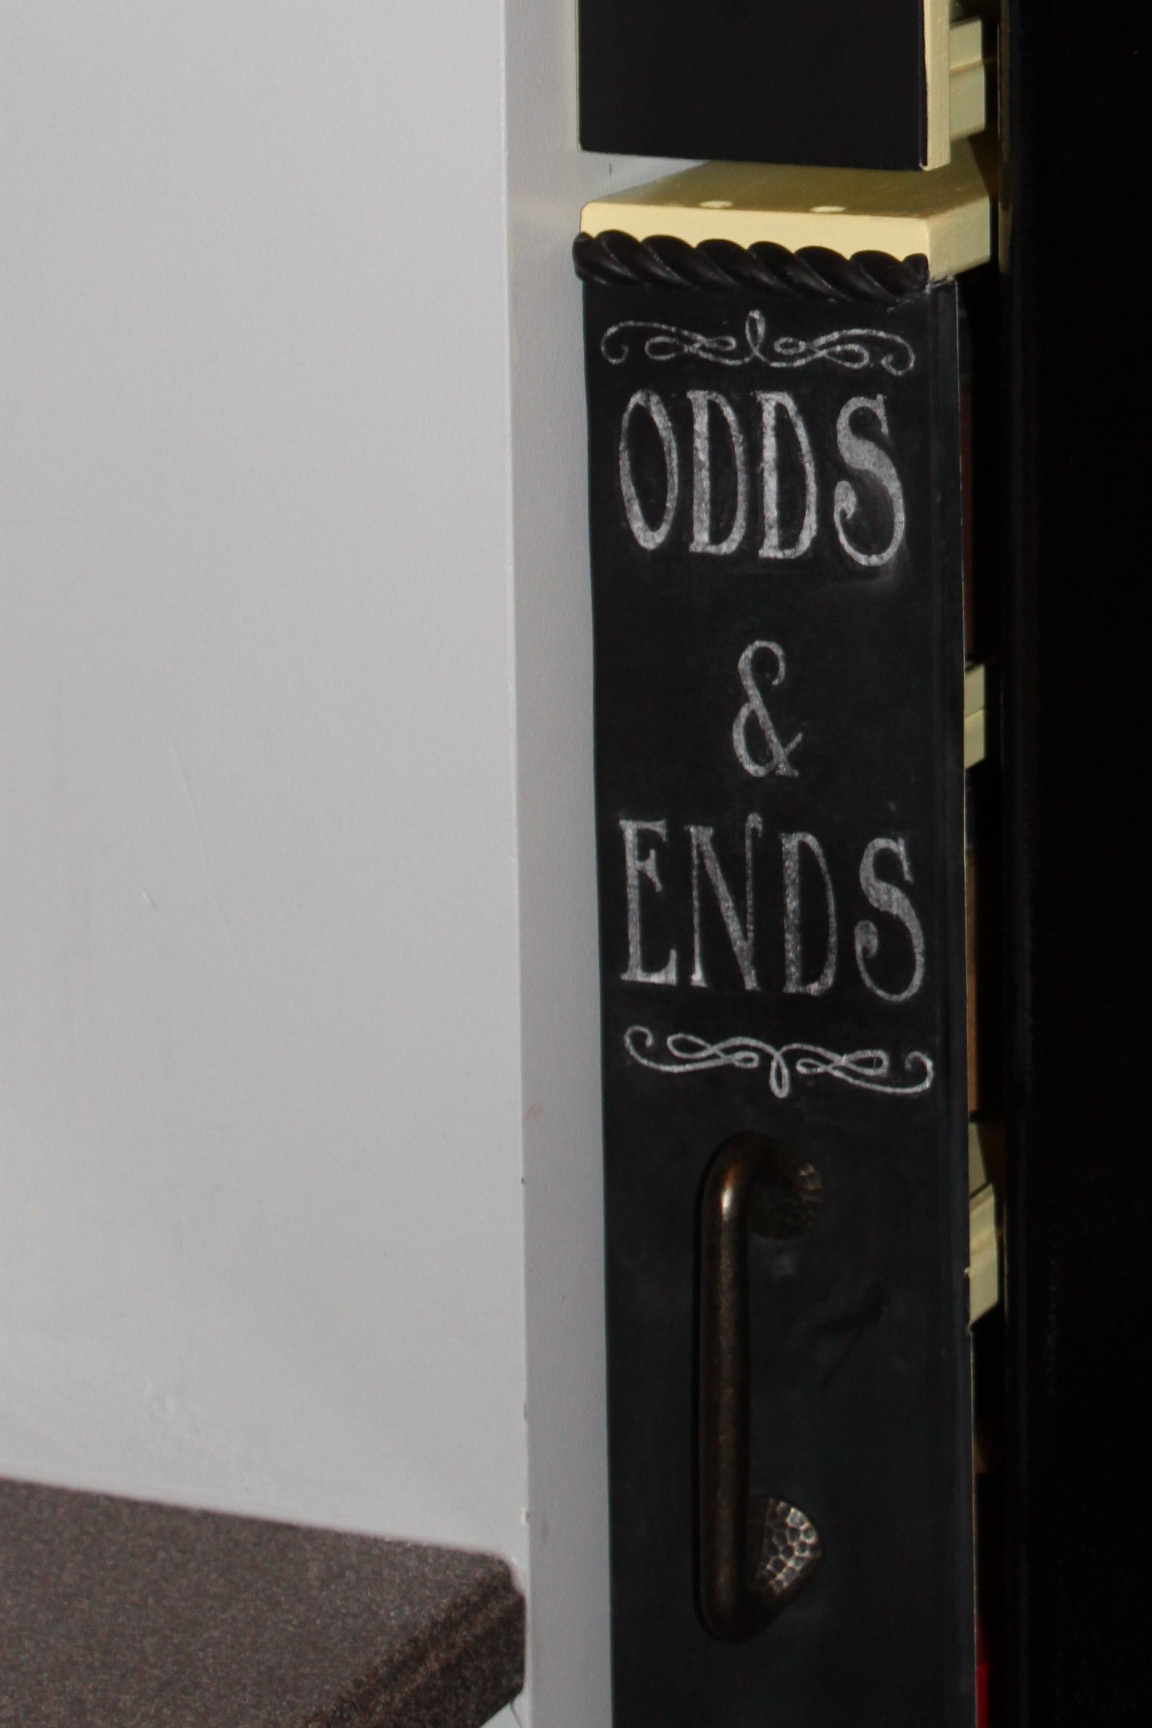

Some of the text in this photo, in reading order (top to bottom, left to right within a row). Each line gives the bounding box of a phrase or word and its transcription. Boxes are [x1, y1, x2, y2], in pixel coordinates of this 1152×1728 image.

[619, 390, 907, 568] ODDS
[733, 641, 804, 778] &
[619, 814, 926, 1002] ENDS
